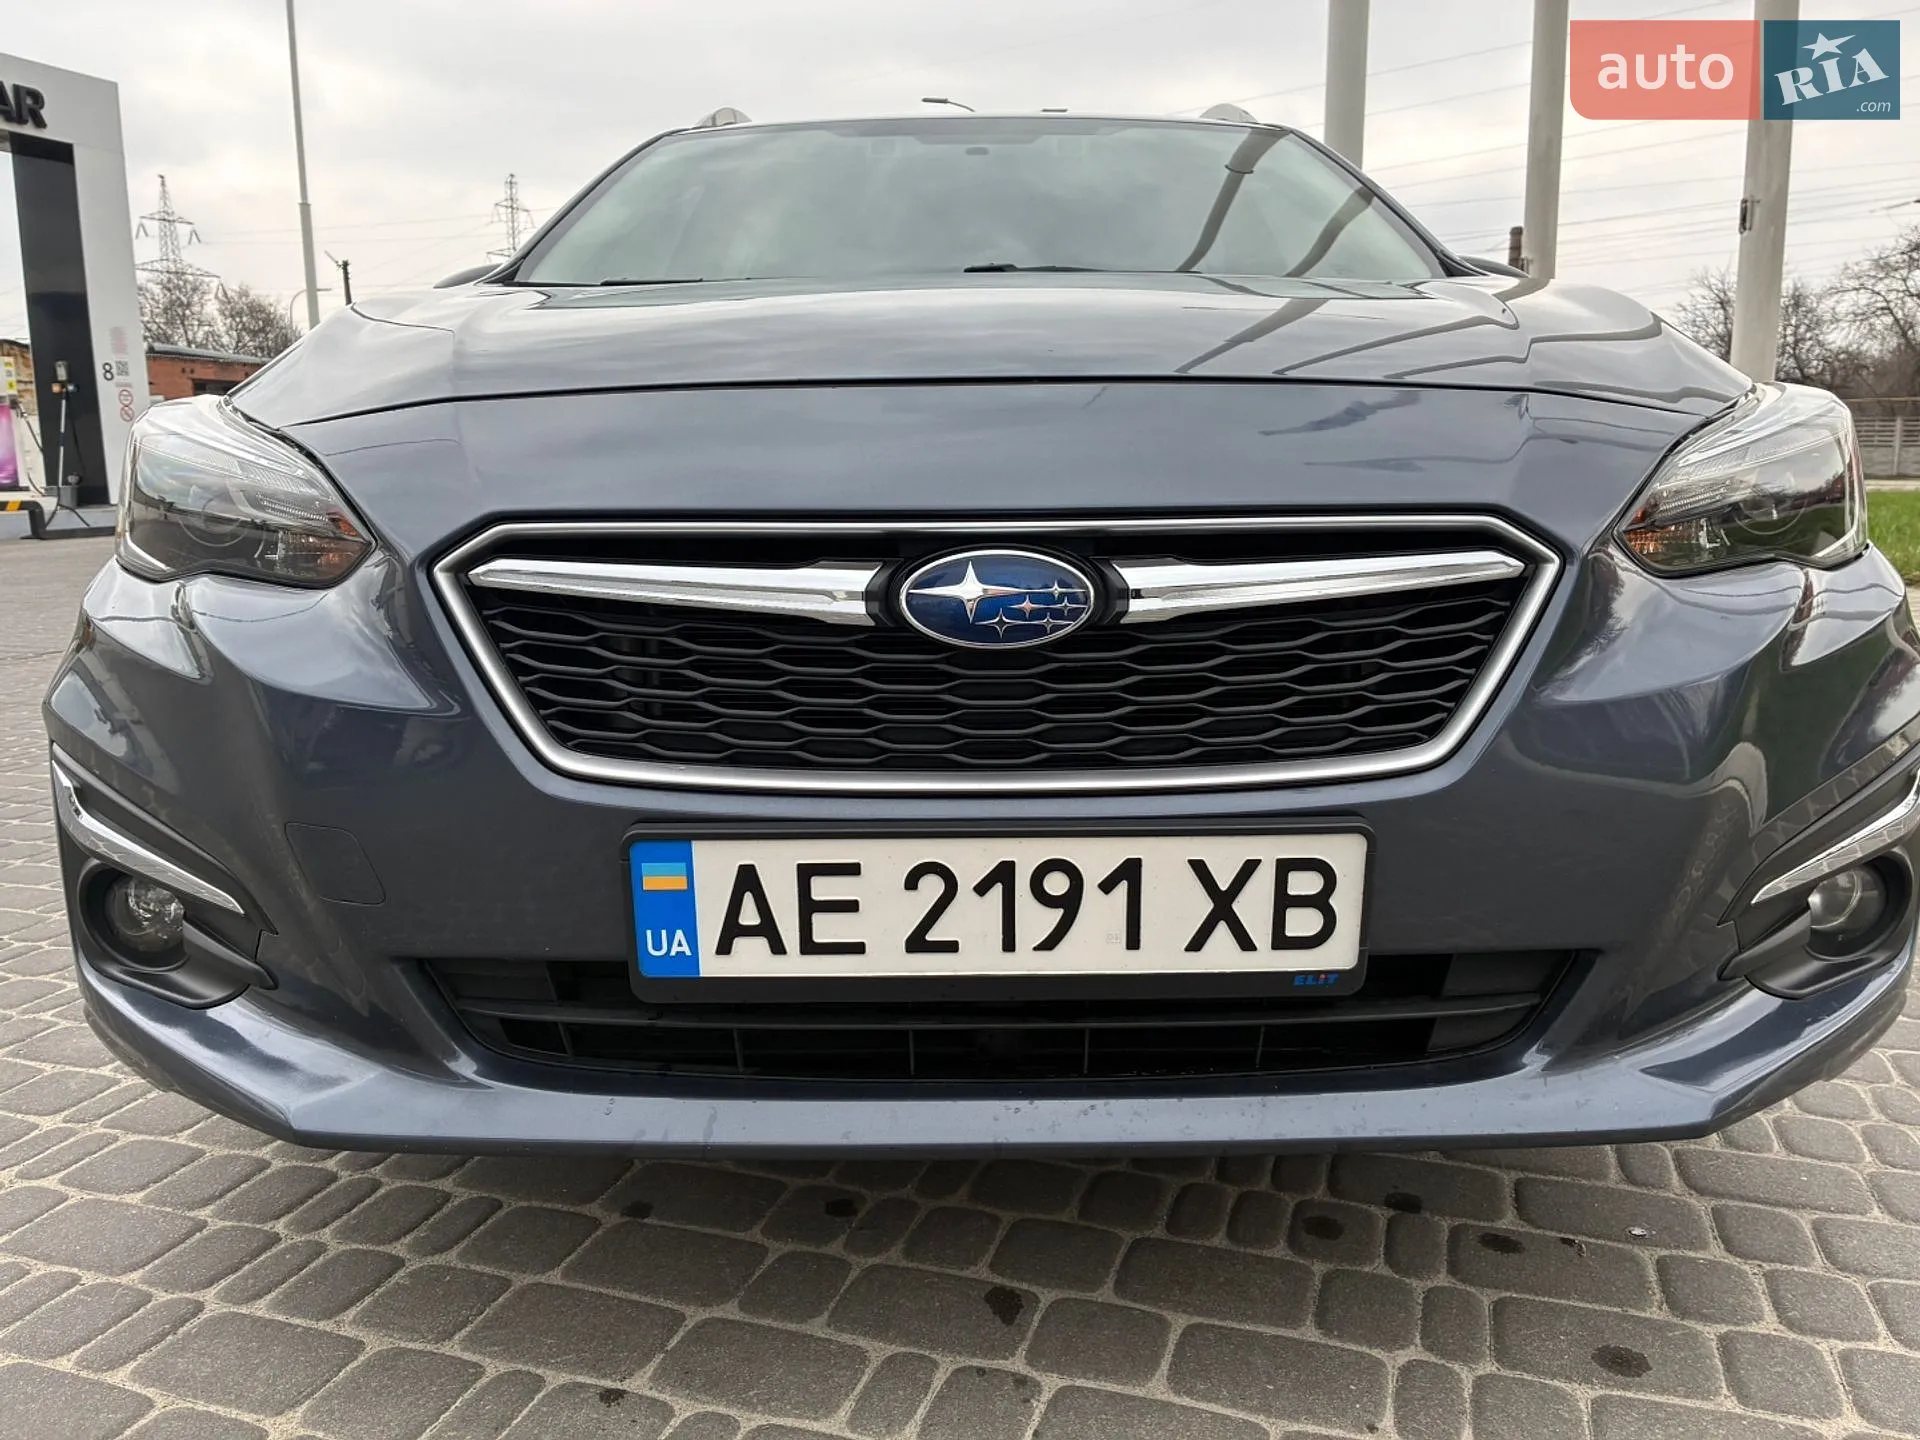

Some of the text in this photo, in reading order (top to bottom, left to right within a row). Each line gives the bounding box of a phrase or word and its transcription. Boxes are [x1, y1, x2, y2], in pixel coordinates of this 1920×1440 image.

[102, 362, 114, 381] 8
[715, 857, 1338, 956] AE 2191 XB
[646, 929, 692, 957] UA
